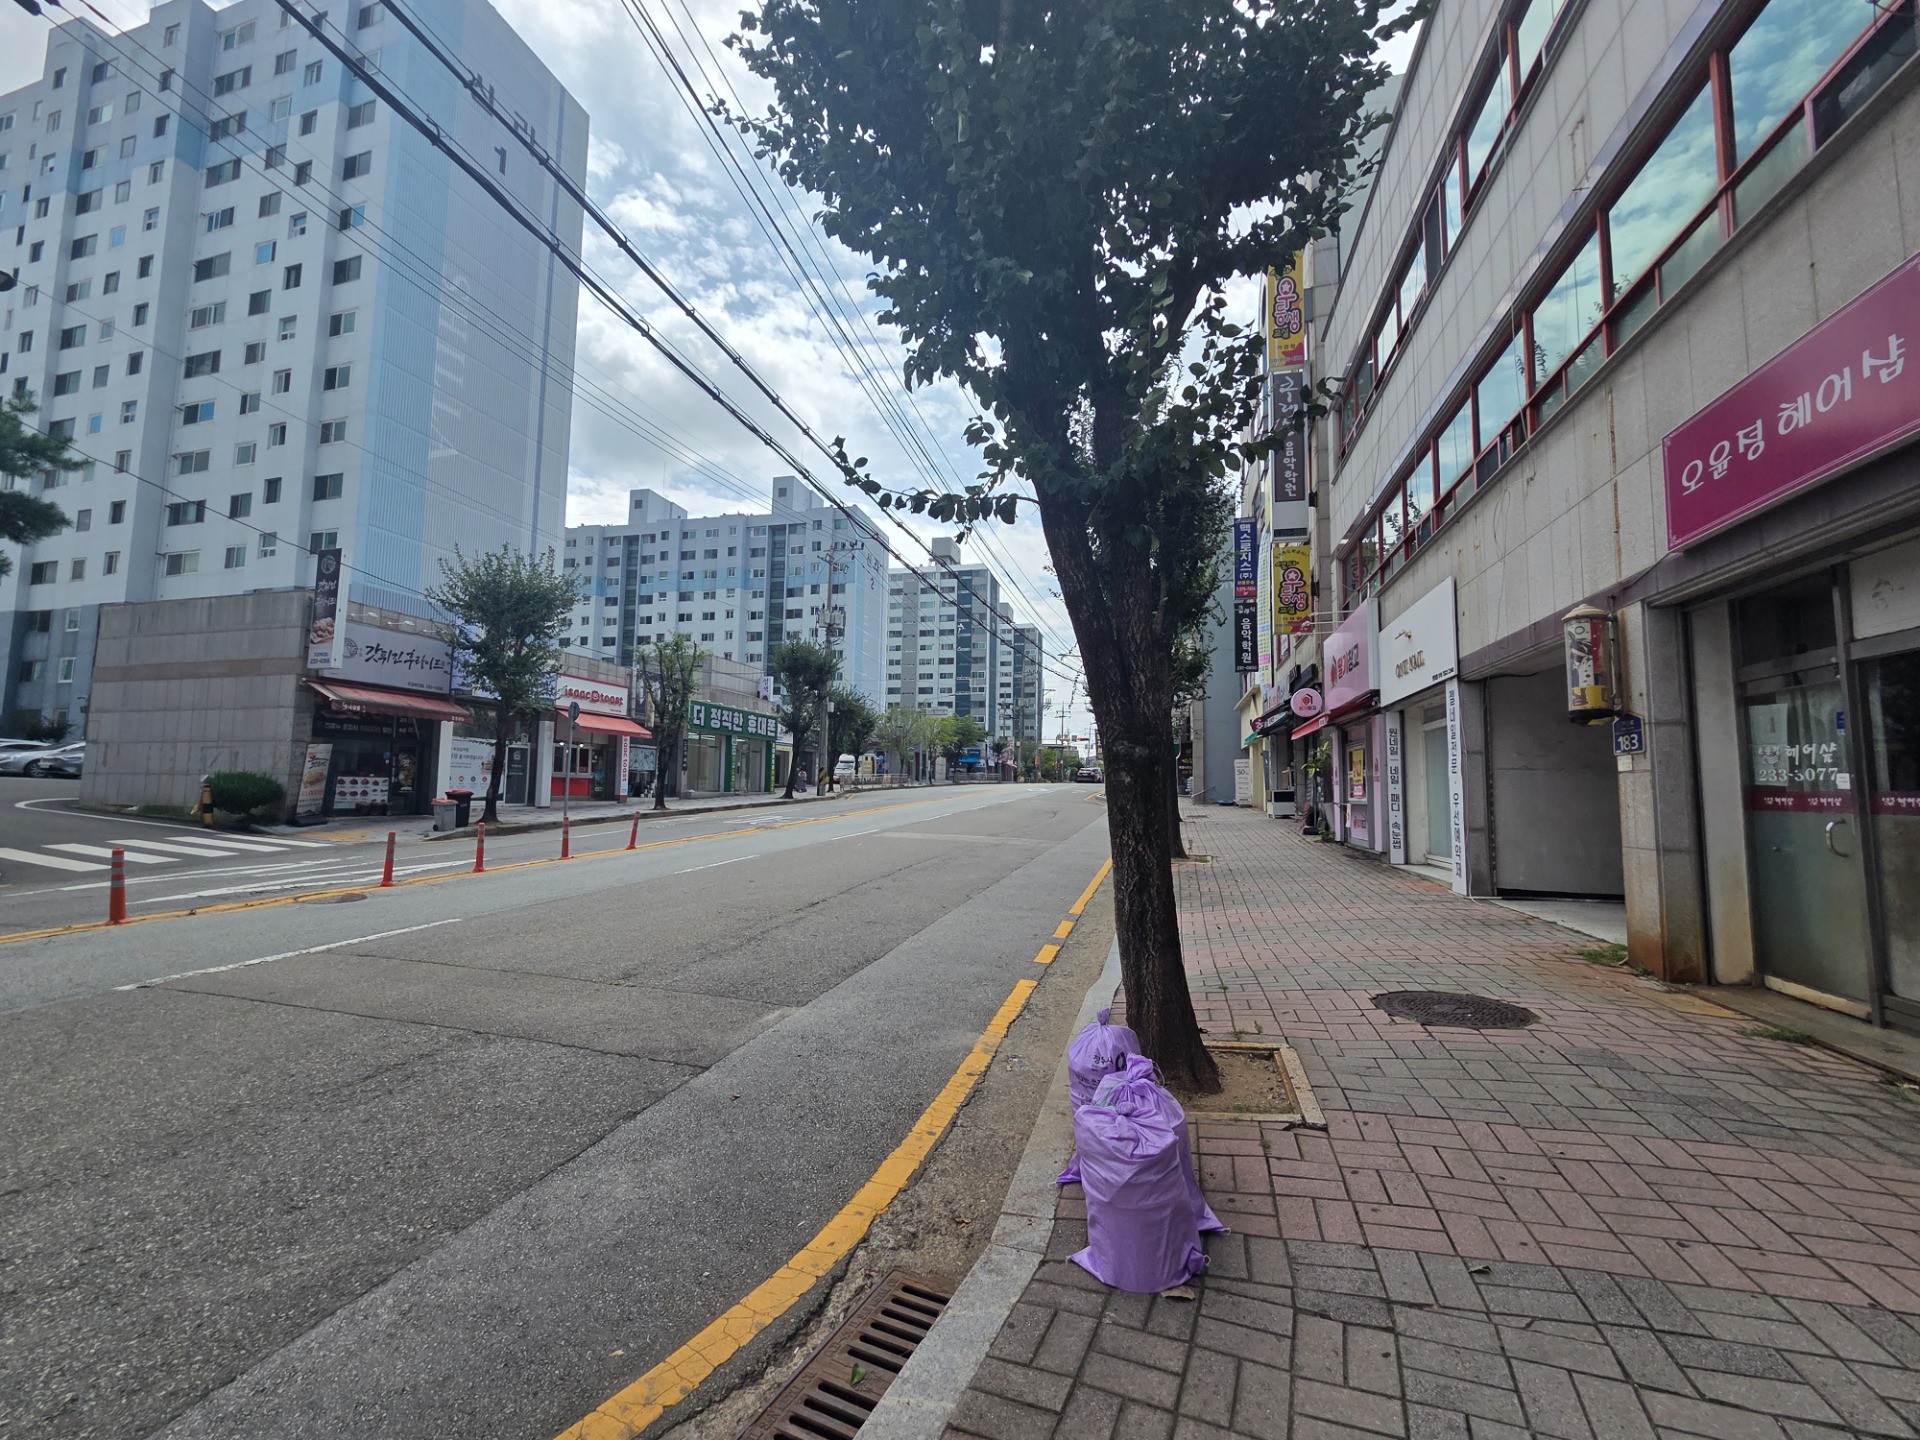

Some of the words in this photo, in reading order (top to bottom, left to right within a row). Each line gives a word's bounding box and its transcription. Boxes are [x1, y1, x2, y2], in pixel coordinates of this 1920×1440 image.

[1275, 277, 1301, 332] 우등생
[1283, 441, 1298, 497] 음악학원
[1681, 419, 1765, 496] 오윤정
[1280, 568, 1307, 611] 우등생
[1241, 617, 1252, 664] 음악학원
[1337, 643, 1360, 680] 딸기창고
[565, 685, 591, 700] isaac
[601, 692, 624, 706] toast
[693, 704, 705, 727] 더
[710, 707, 743, 732] 정직한
[748, 714, 776, 738] 휴대폰
[1388, 727, 1398, 756] 원네일
[1617, 733, 1639, 751] 183
